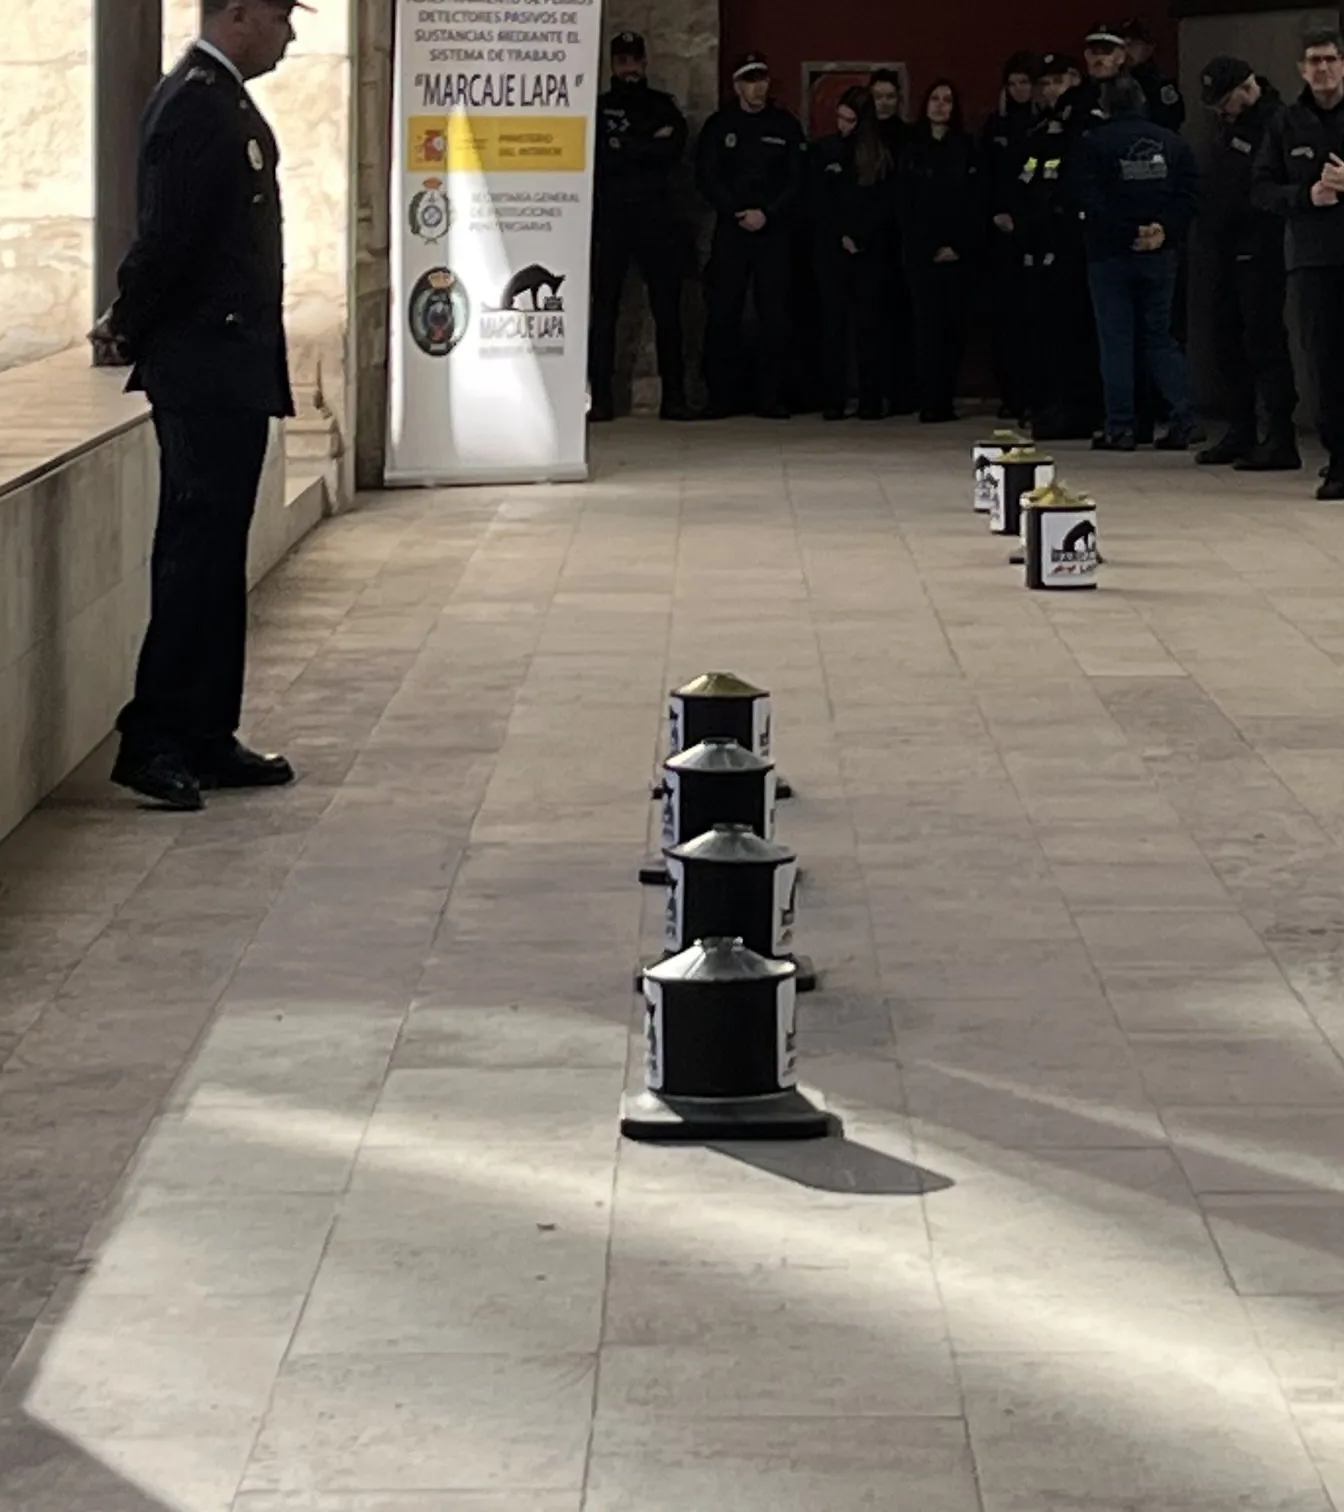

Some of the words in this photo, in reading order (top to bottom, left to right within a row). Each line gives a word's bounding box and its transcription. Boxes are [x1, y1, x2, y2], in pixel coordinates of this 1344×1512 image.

[418, 10, 501, 24] DETECTORES
[504, 11, 558, 24] PASIVOS
[561, 12, 578, 24] DE
[414, 30, 494, 42] SUSTANCIAS
[566, 31, 580, 44] EL
[430, 49, 484, 62] SISTEMA
[487, 50, 504, 62] DE
[507, 50, 567, 62] TRABAJO
[520, 73, 570, 107] LAPA
